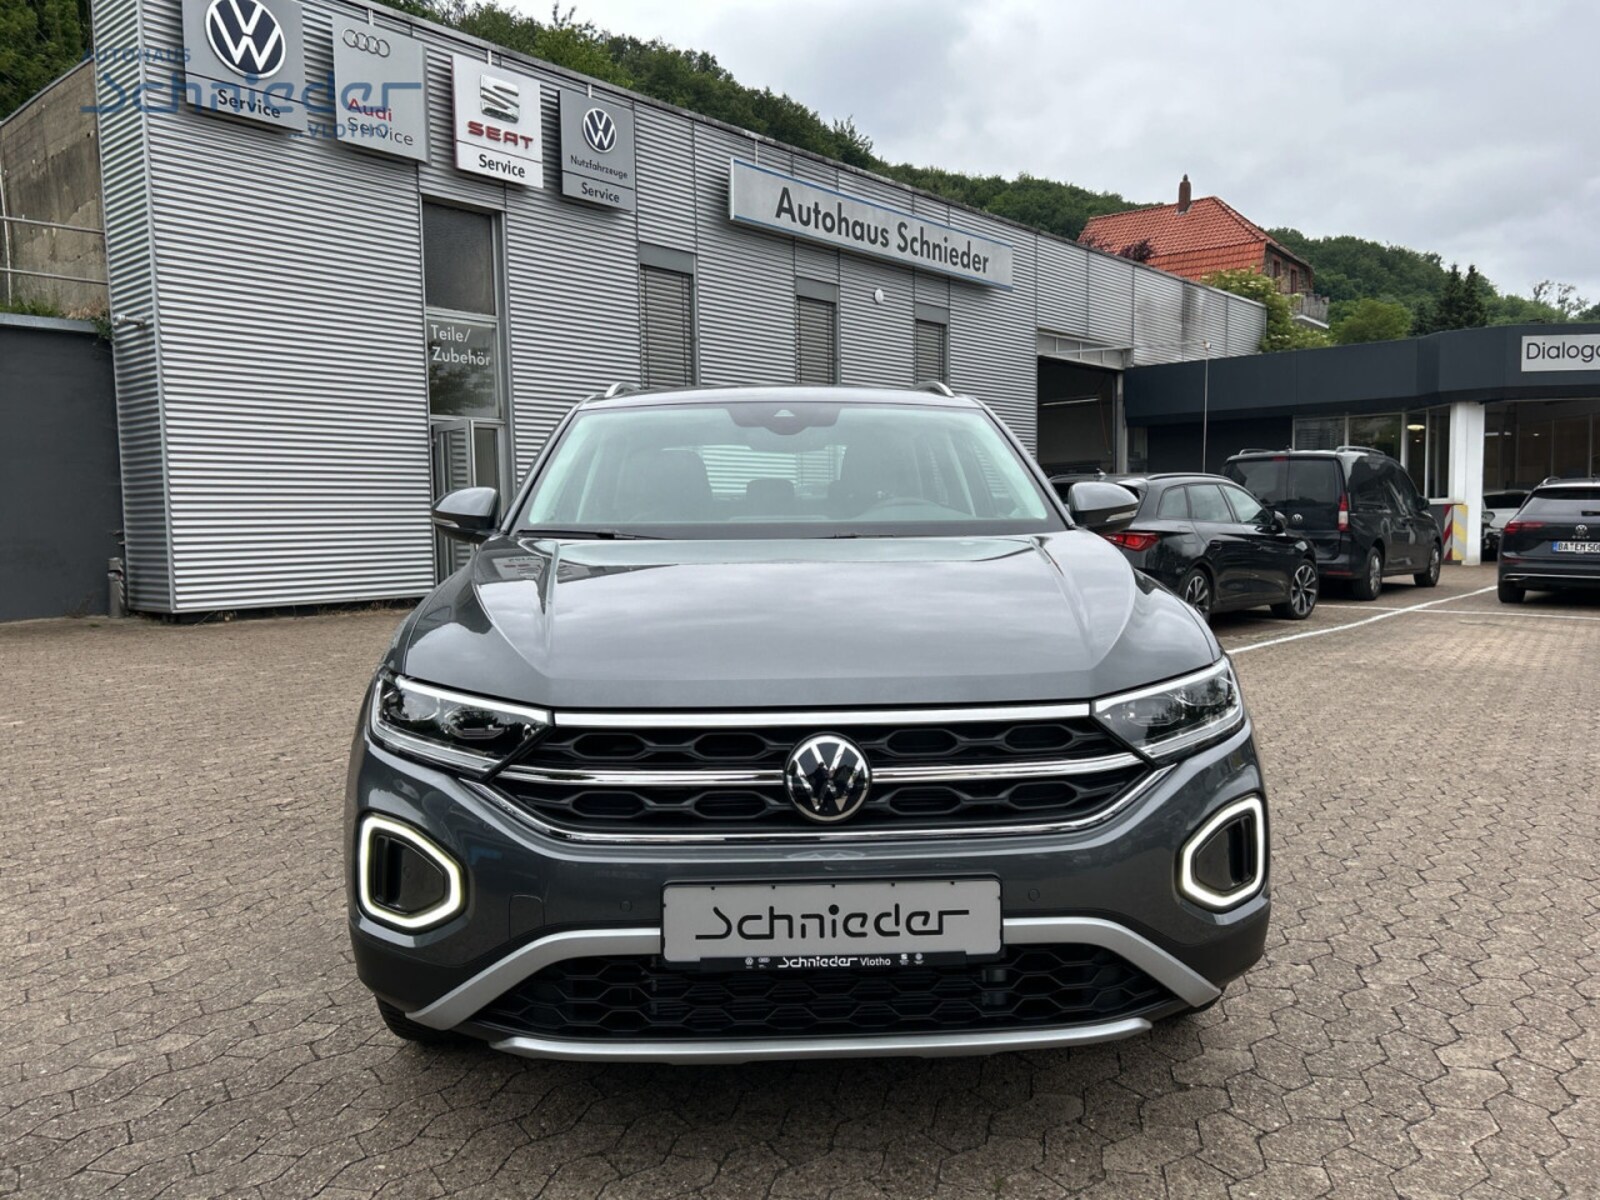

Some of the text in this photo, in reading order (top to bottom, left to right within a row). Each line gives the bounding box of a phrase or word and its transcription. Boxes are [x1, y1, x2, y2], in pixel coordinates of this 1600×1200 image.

[217, 88, 281, 119] Service
[347, 98, 392, 122] Audi
[347, 116, 414, 146] Service
[467, 120, 534, 149] SEAT
[478, 153, 526, 178] Service
[570, 154, 629, 180] Nutzfahrzeuge
[581, 181, 621, 204] Service
[775, 186, 990, 274] Autohaus Schnieder
[430, 324, 471, 343] Teile/
[431, 346, 491, 366] Zubehör
[695, 903, 970, 940] Schnieder
[777, 955, 858, 969] Schnieder
[859, 957, 891, 966] Vlotho
